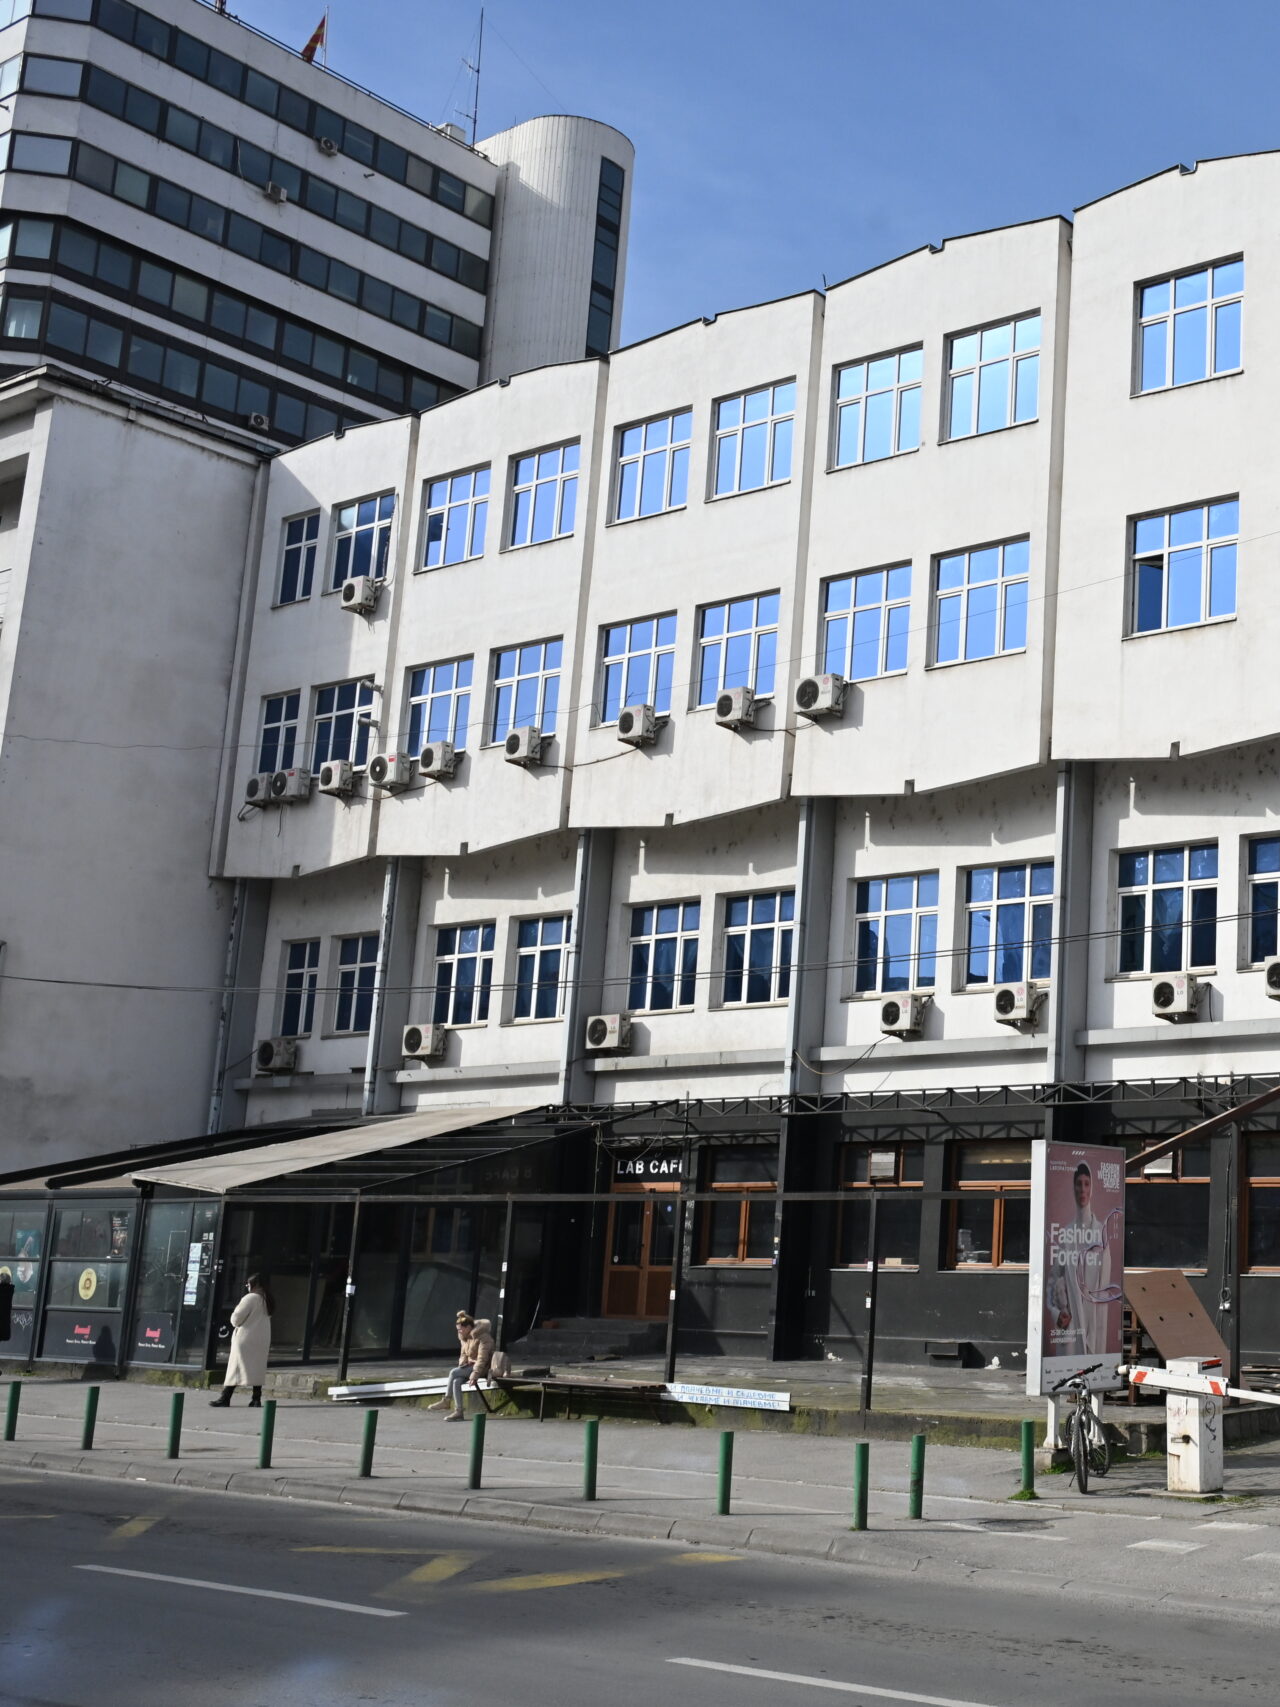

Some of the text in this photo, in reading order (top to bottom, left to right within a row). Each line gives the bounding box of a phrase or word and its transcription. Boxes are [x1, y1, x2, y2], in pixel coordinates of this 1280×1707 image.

[617, 1160, 683, 1174] LAB CAF
[1050, 1223, 1101, 1244] Fashion
[1050, 1246, 1102, 1266] Forever.
